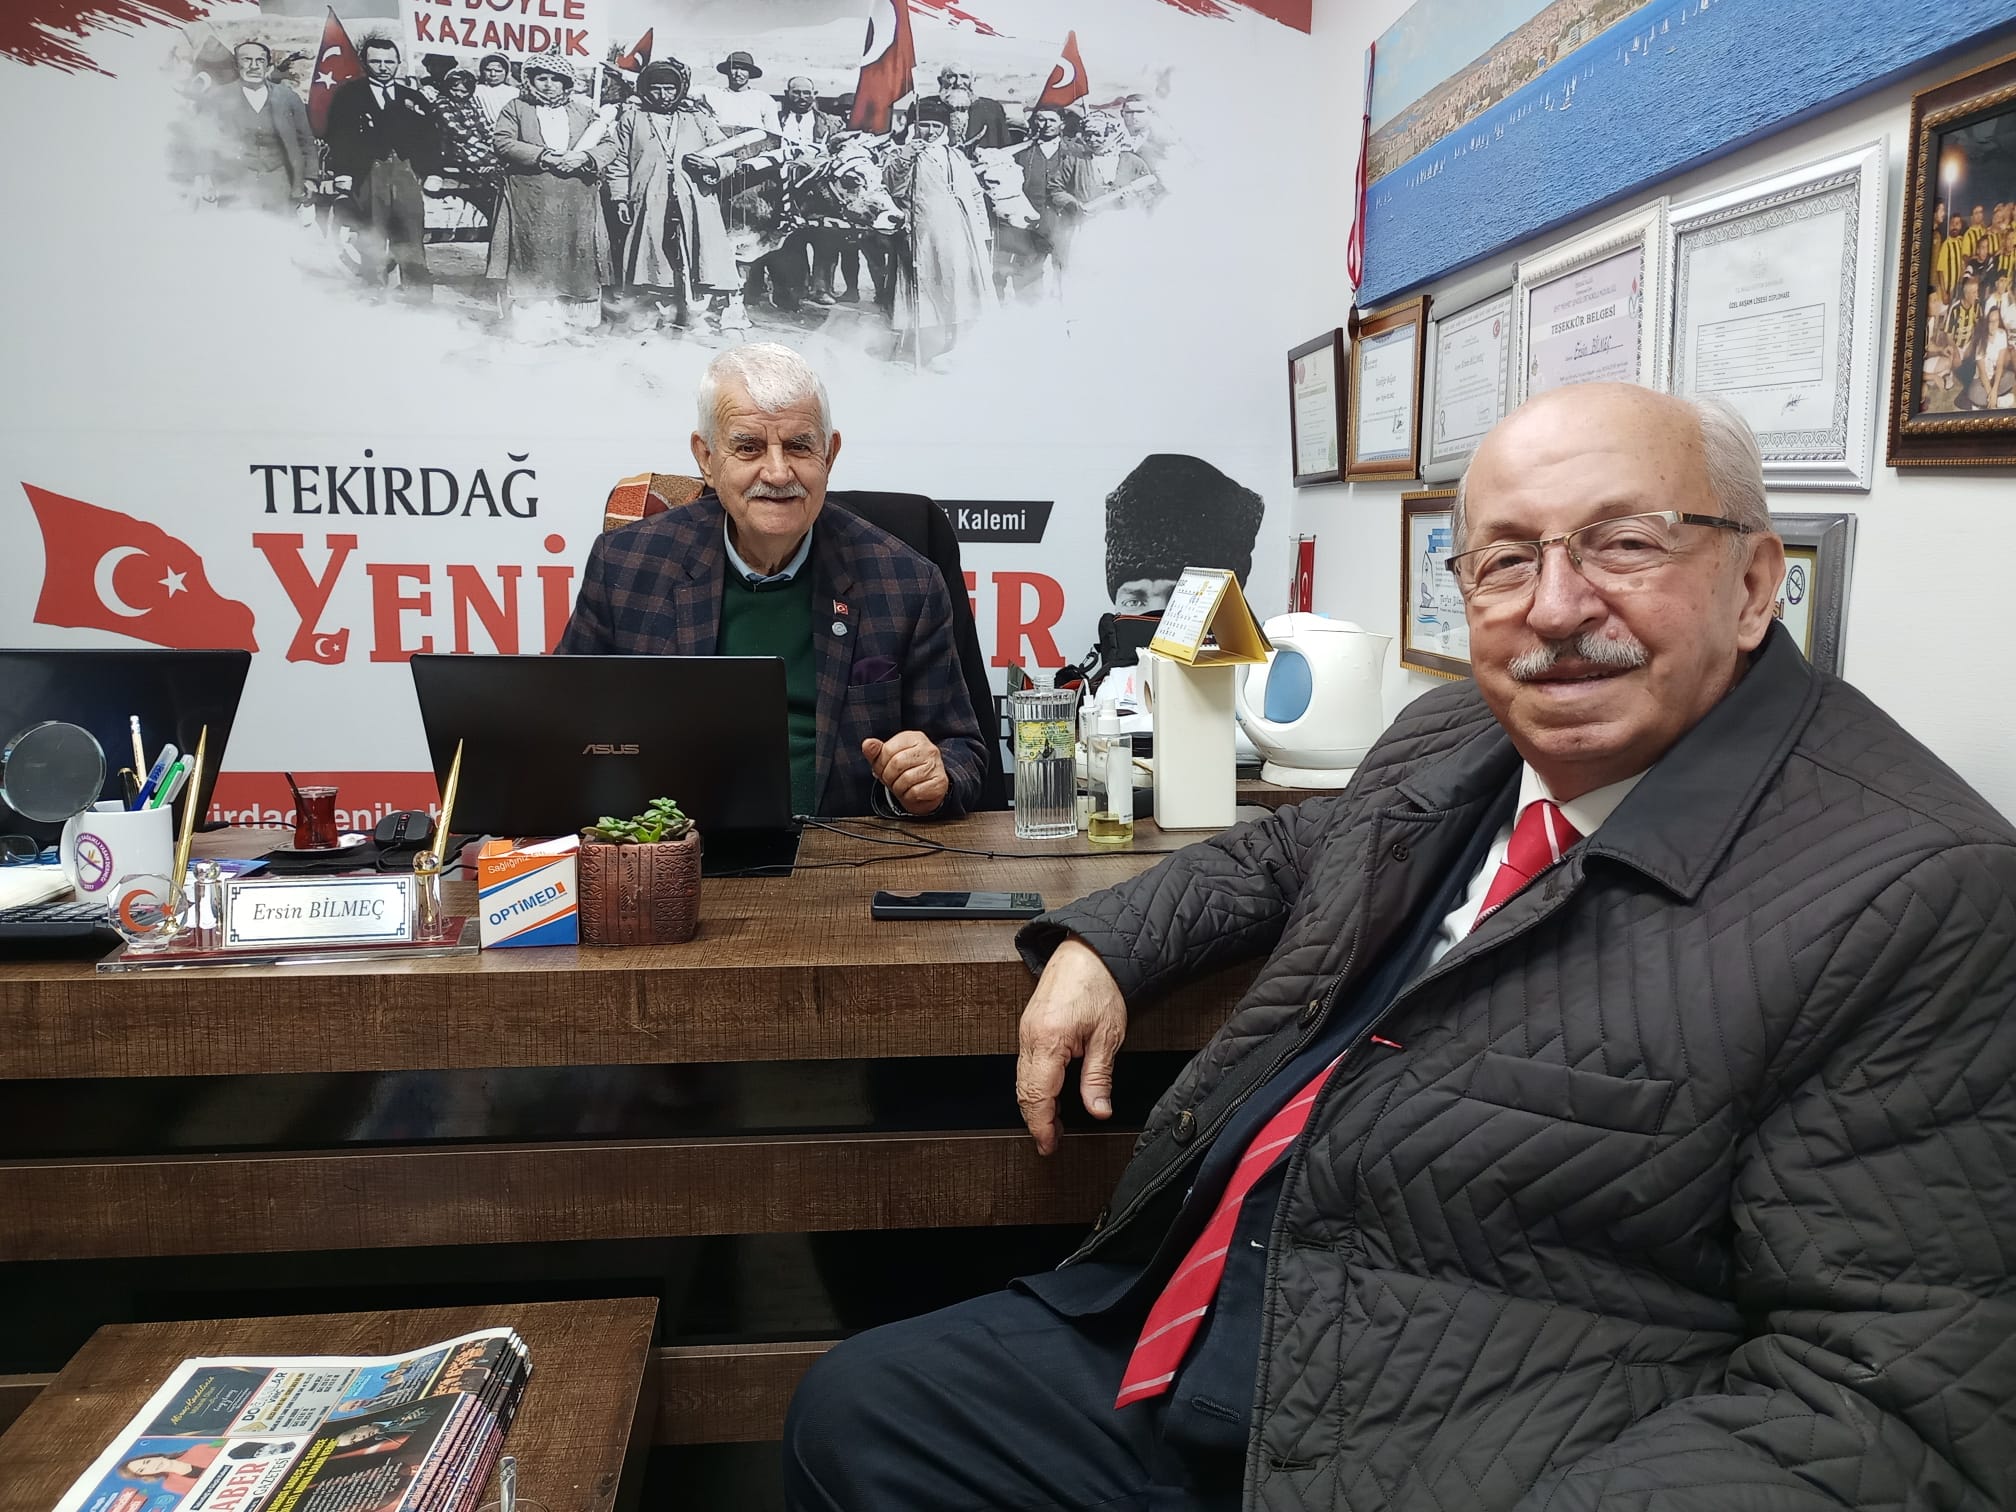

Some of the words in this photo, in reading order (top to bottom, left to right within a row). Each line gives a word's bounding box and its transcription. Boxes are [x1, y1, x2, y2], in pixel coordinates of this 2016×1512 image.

[414, 11, 590, 56] KAZANDIK
[249, 448, 539, 518] TEKİRDAĞ
[957, 508, 1027, 531] Kalemi
[252, 532, 575, 665] YENİ
[582, 744, 640, 755] ASUS
[253, 902, 303, 921] Ersin
[308, 897, 385, 920] BİLMEÇ
[208, 1461, 270, 1512] ABER
[252, 1457, 292, 1496] GAZETESİ
